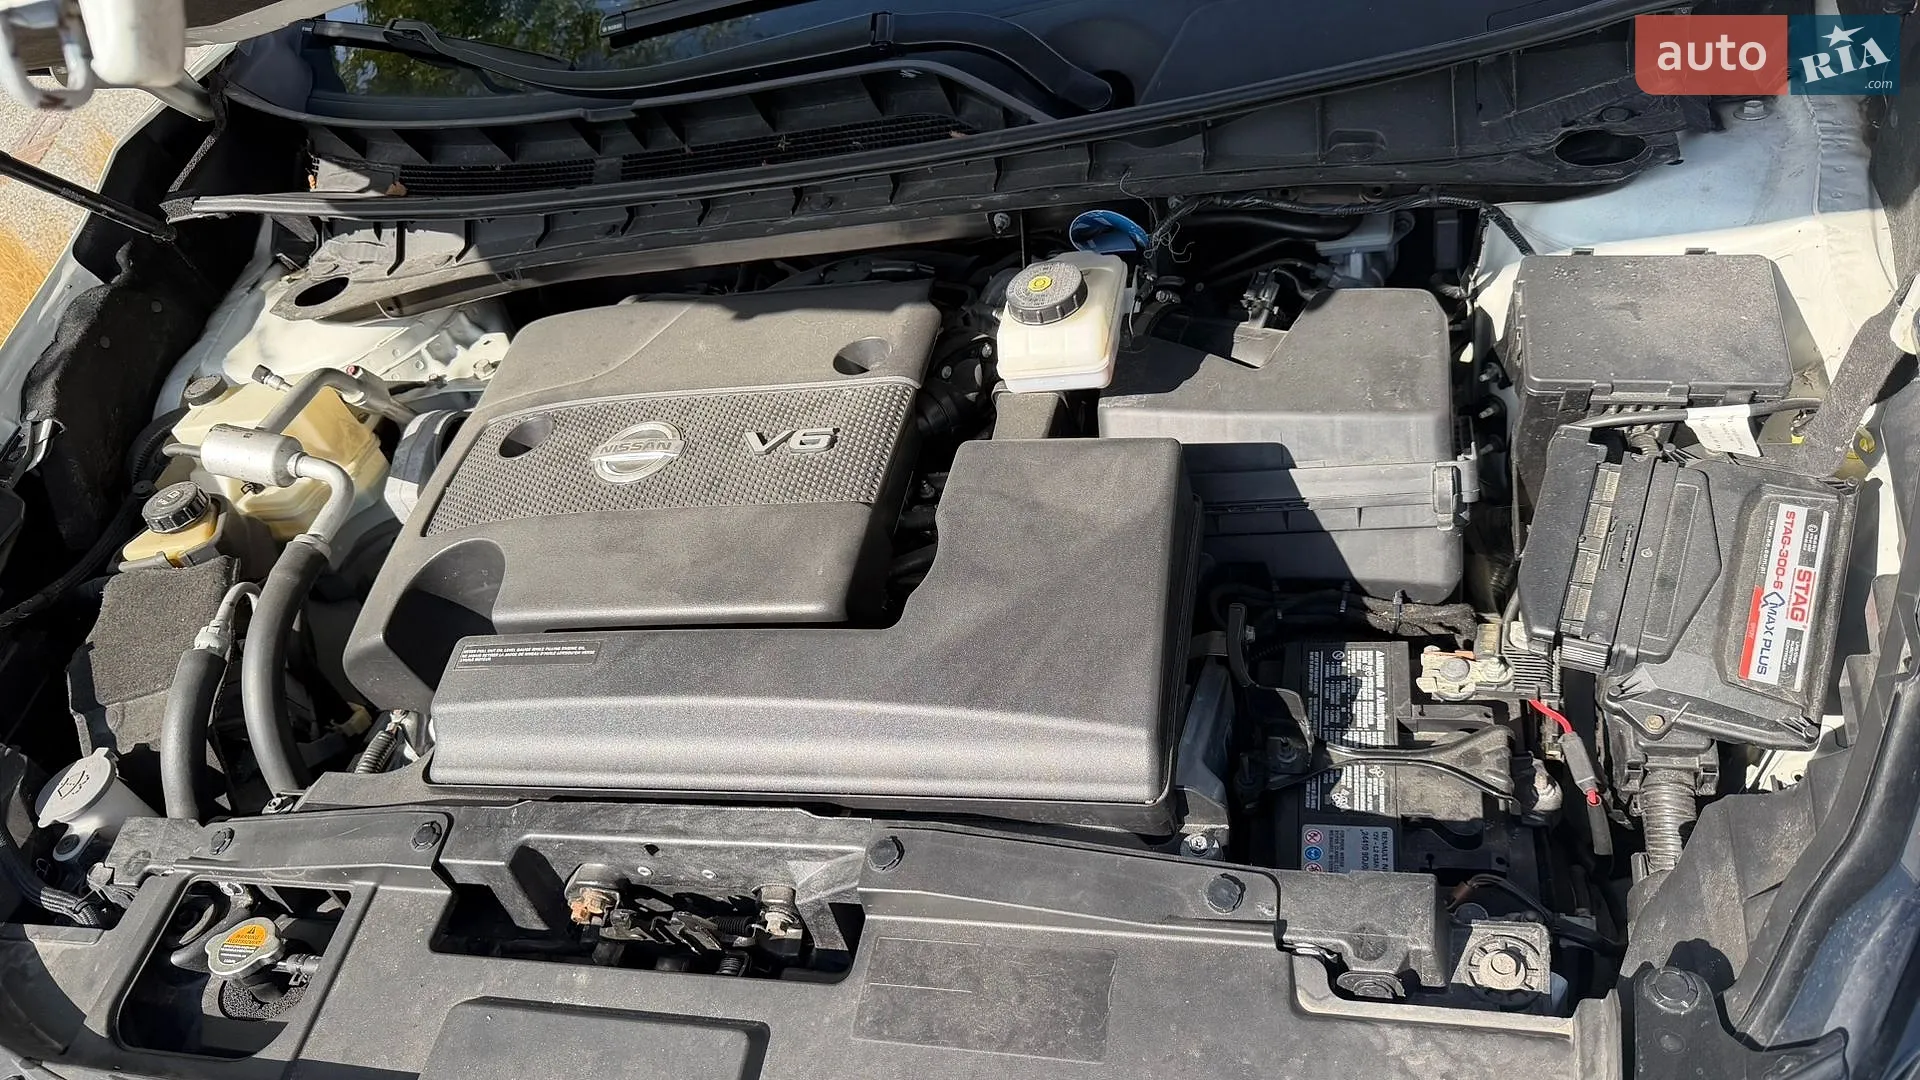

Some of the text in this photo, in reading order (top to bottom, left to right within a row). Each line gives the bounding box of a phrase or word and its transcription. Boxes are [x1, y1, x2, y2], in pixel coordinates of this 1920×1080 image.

[602, 440, 671, 454] NISSAN
[745, 428, 840, 455] V6
[1773, 510, 1796, 590] STAG-300-6
[1790, 568, 1813, 622] STAG
[1757, 602, 1778, 675] MAX PLUS
